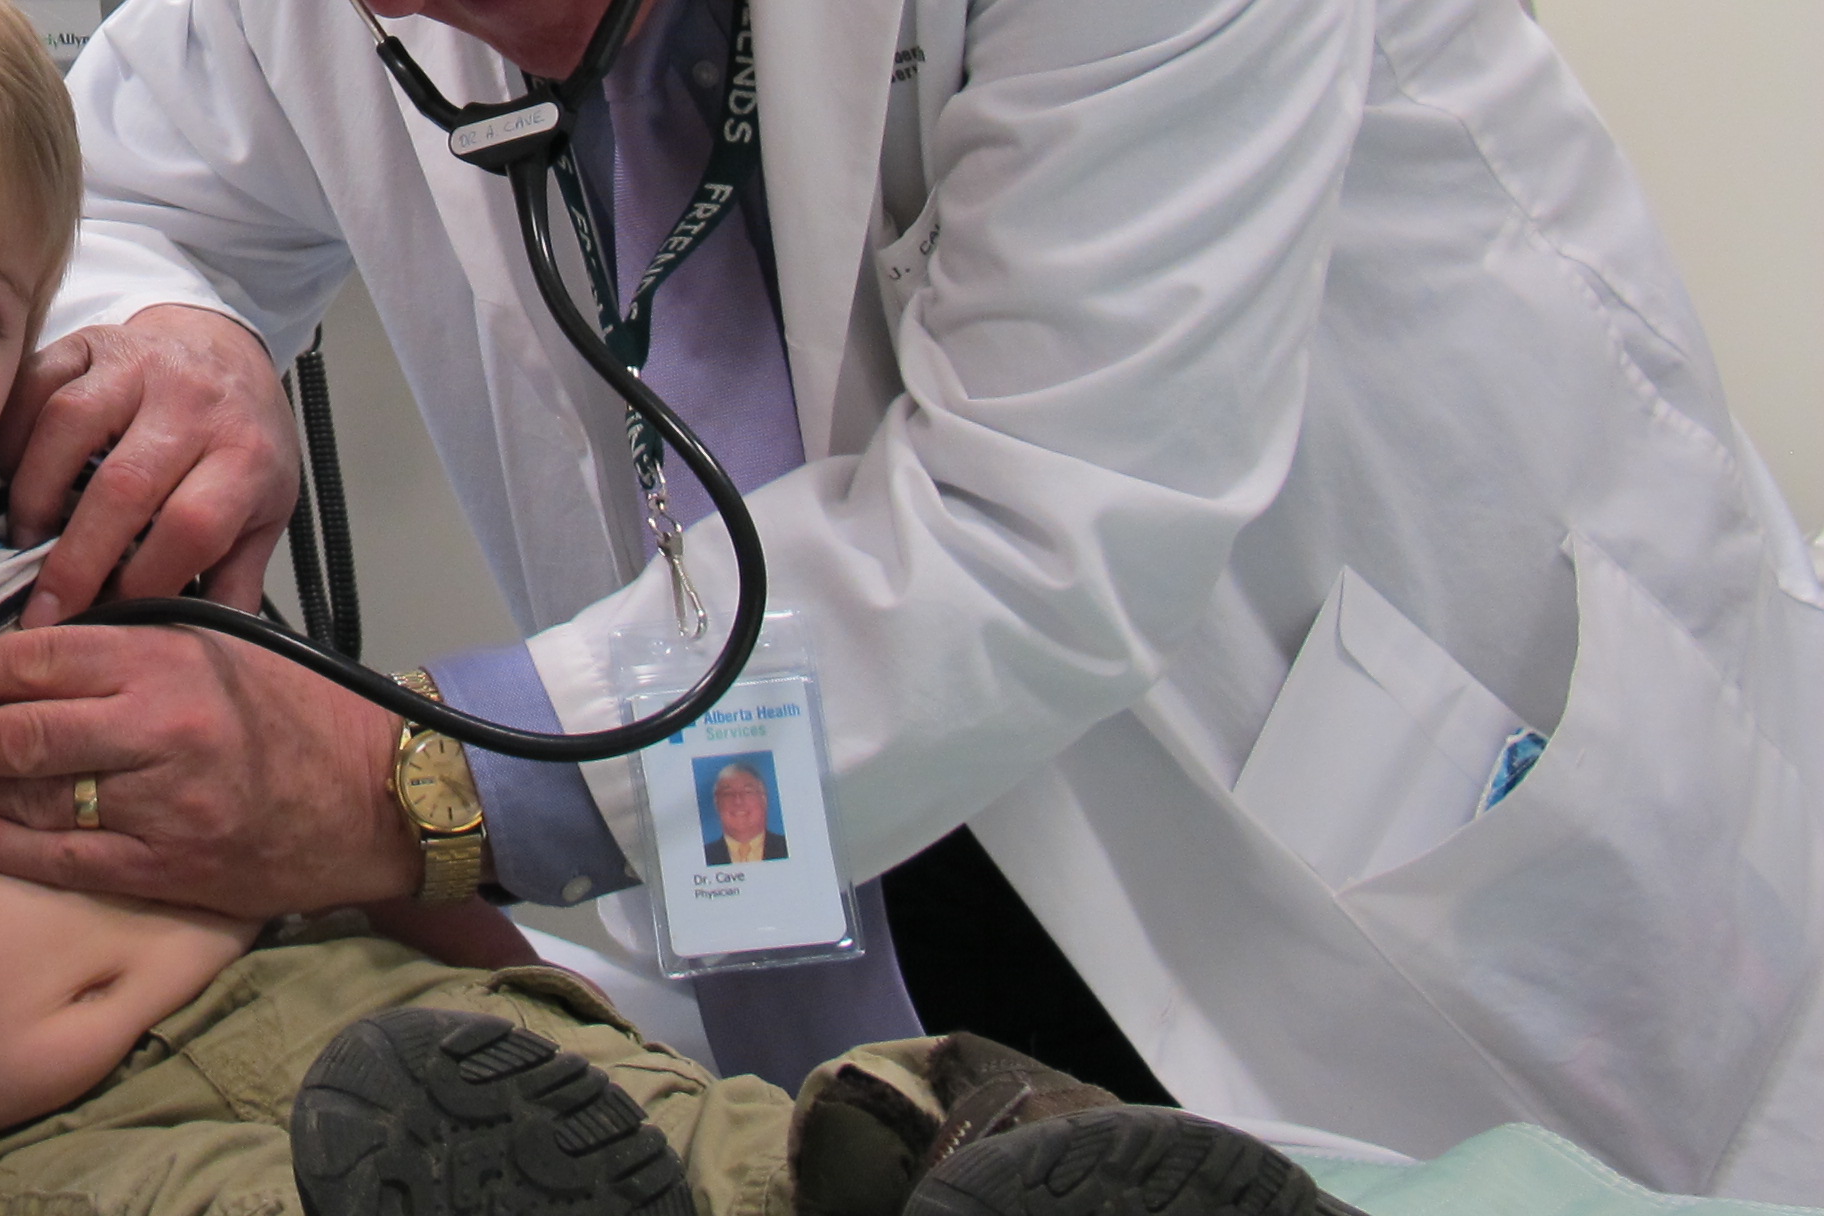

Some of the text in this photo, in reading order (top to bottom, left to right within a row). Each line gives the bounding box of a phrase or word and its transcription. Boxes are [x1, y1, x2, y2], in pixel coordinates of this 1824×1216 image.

[504, 109, 545, 132] CAVE
[920, 223, 940, 255] CA
[704, 703, 801, 725] Alberta Health
[706, 725, 766, 741] Services
[693, 872, 745, 886] Dr. Cave
[694, 887, 740, 899] Physician
